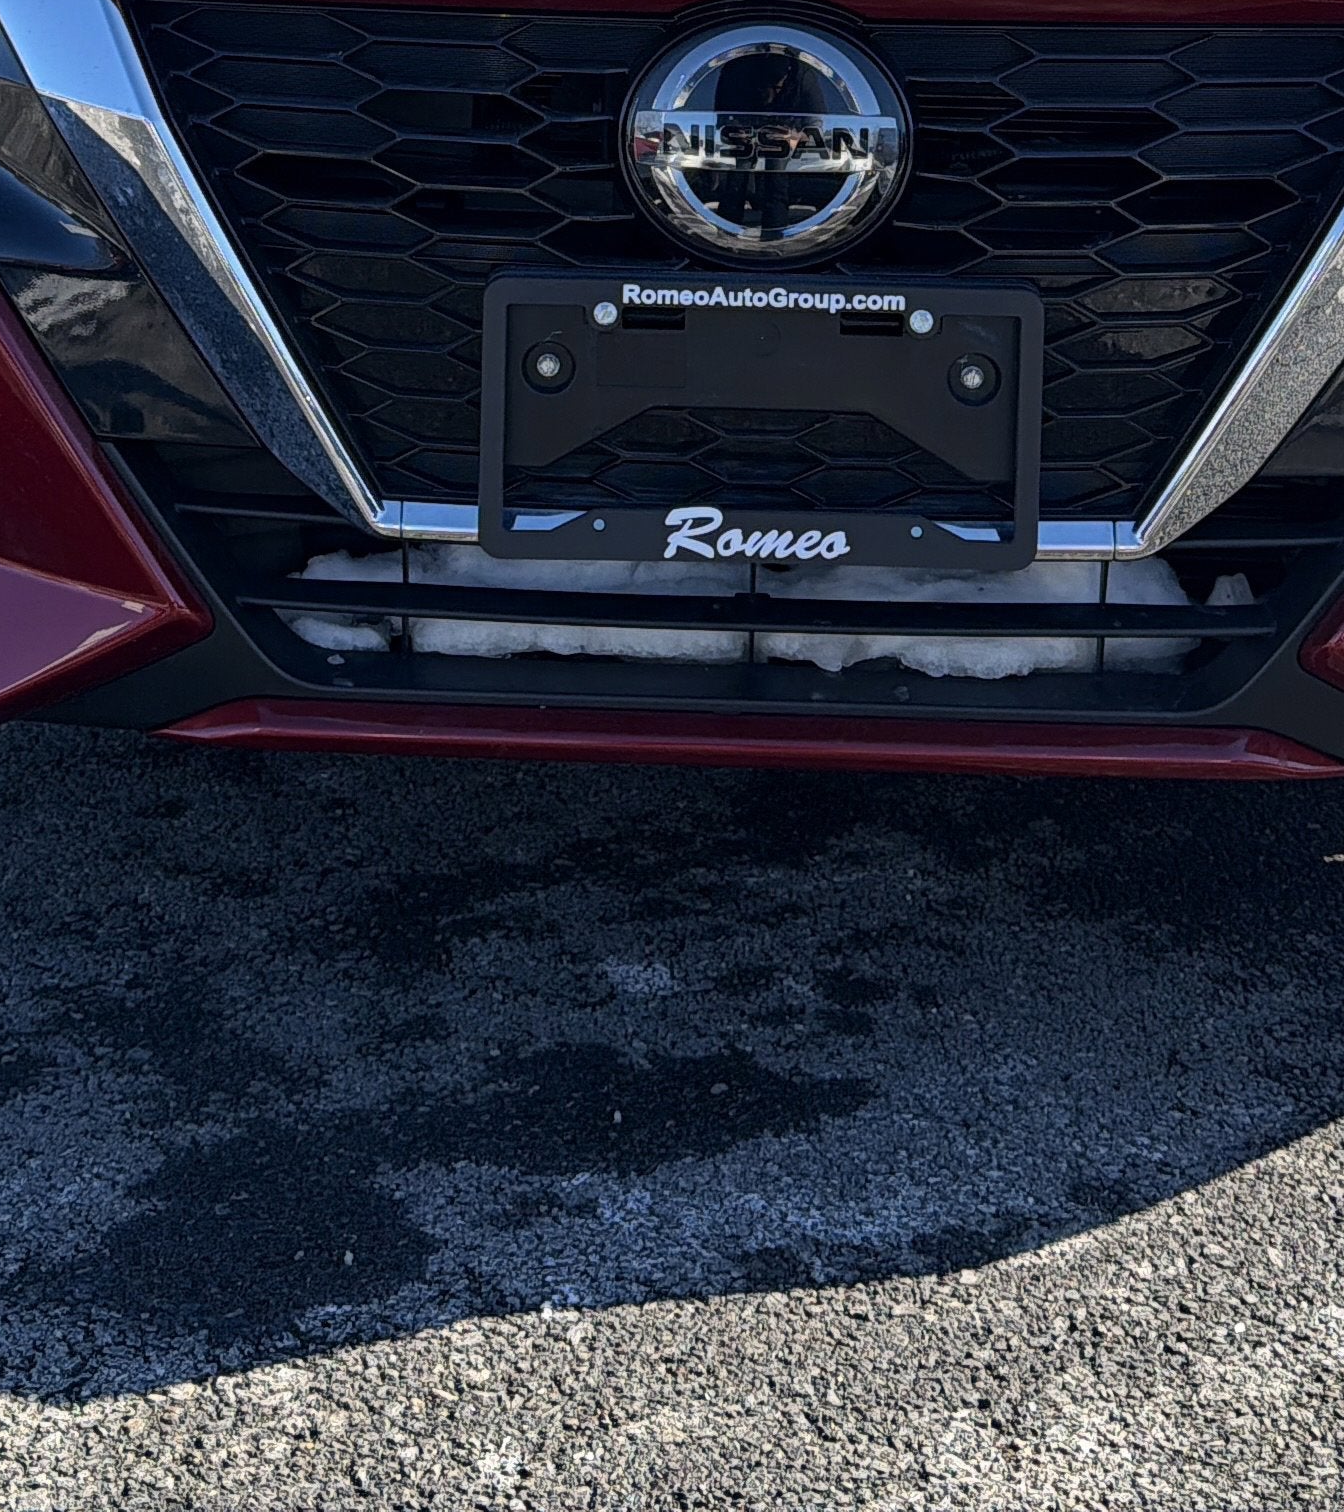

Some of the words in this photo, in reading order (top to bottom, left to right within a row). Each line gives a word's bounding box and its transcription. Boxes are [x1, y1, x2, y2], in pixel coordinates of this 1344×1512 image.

[663, 123, 869, 160] NISSAN
[622, 284, 906, 313] RomeoAutoGroup.com
[663, 506, 851, 560] Romeo
